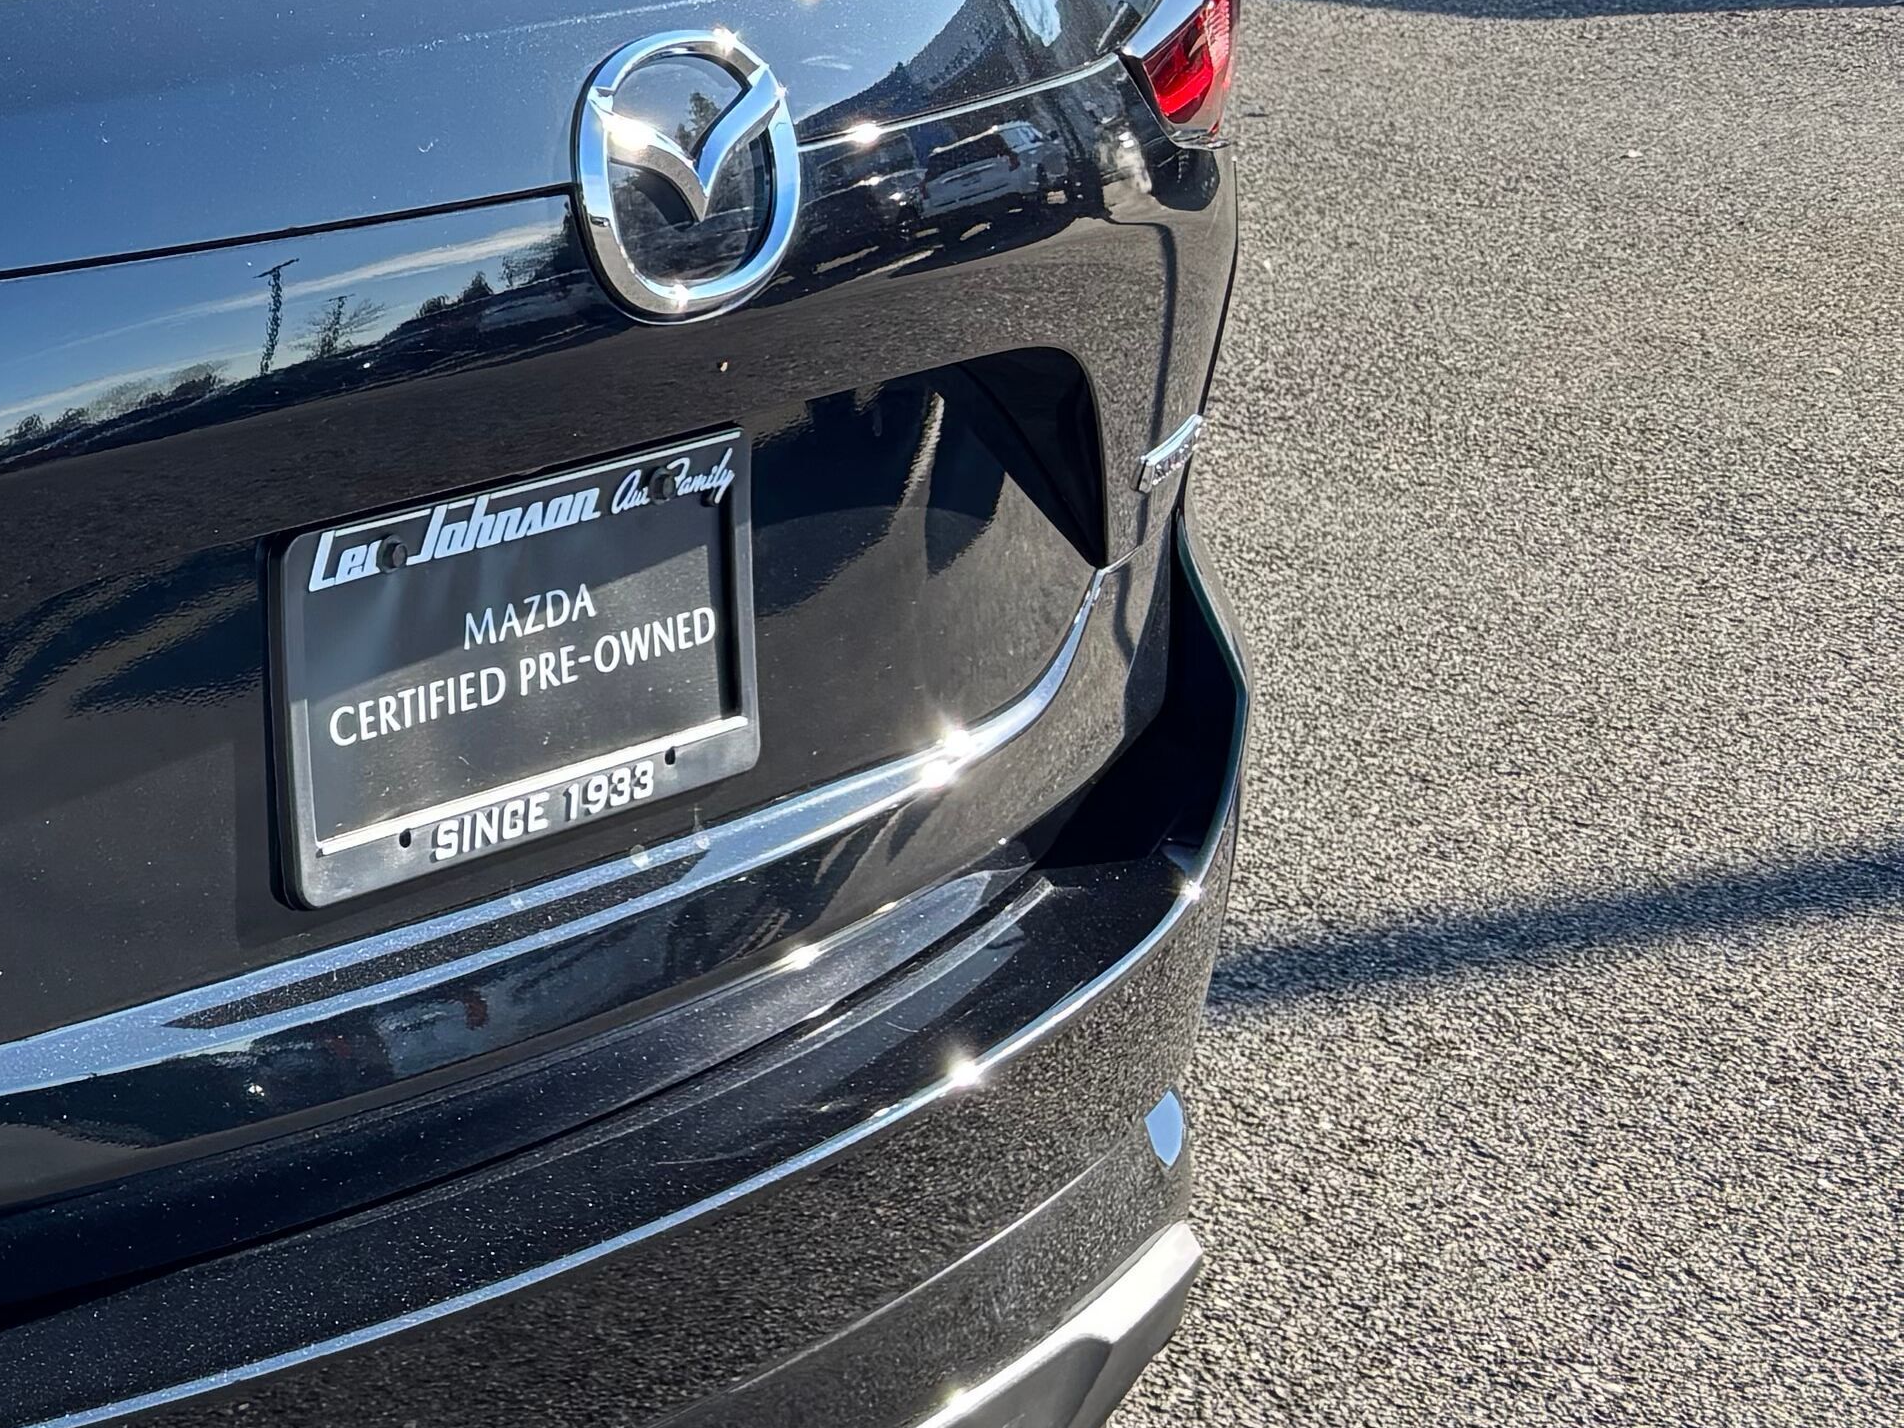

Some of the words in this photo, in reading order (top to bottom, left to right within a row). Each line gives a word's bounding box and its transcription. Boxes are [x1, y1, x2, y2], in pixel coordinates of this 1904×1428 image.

[405, 487, 602, 566] Johnson
[666, 447, 735, 504] Family
[463, 582, 597, 651] MAZDA
[328, 664, 507, 748] CERTIFIED
[519, 605, 717, 697] PRE-OWNED
[433, 790, 550, 861] SINCE
[566, 759, 655, 821] 1933
